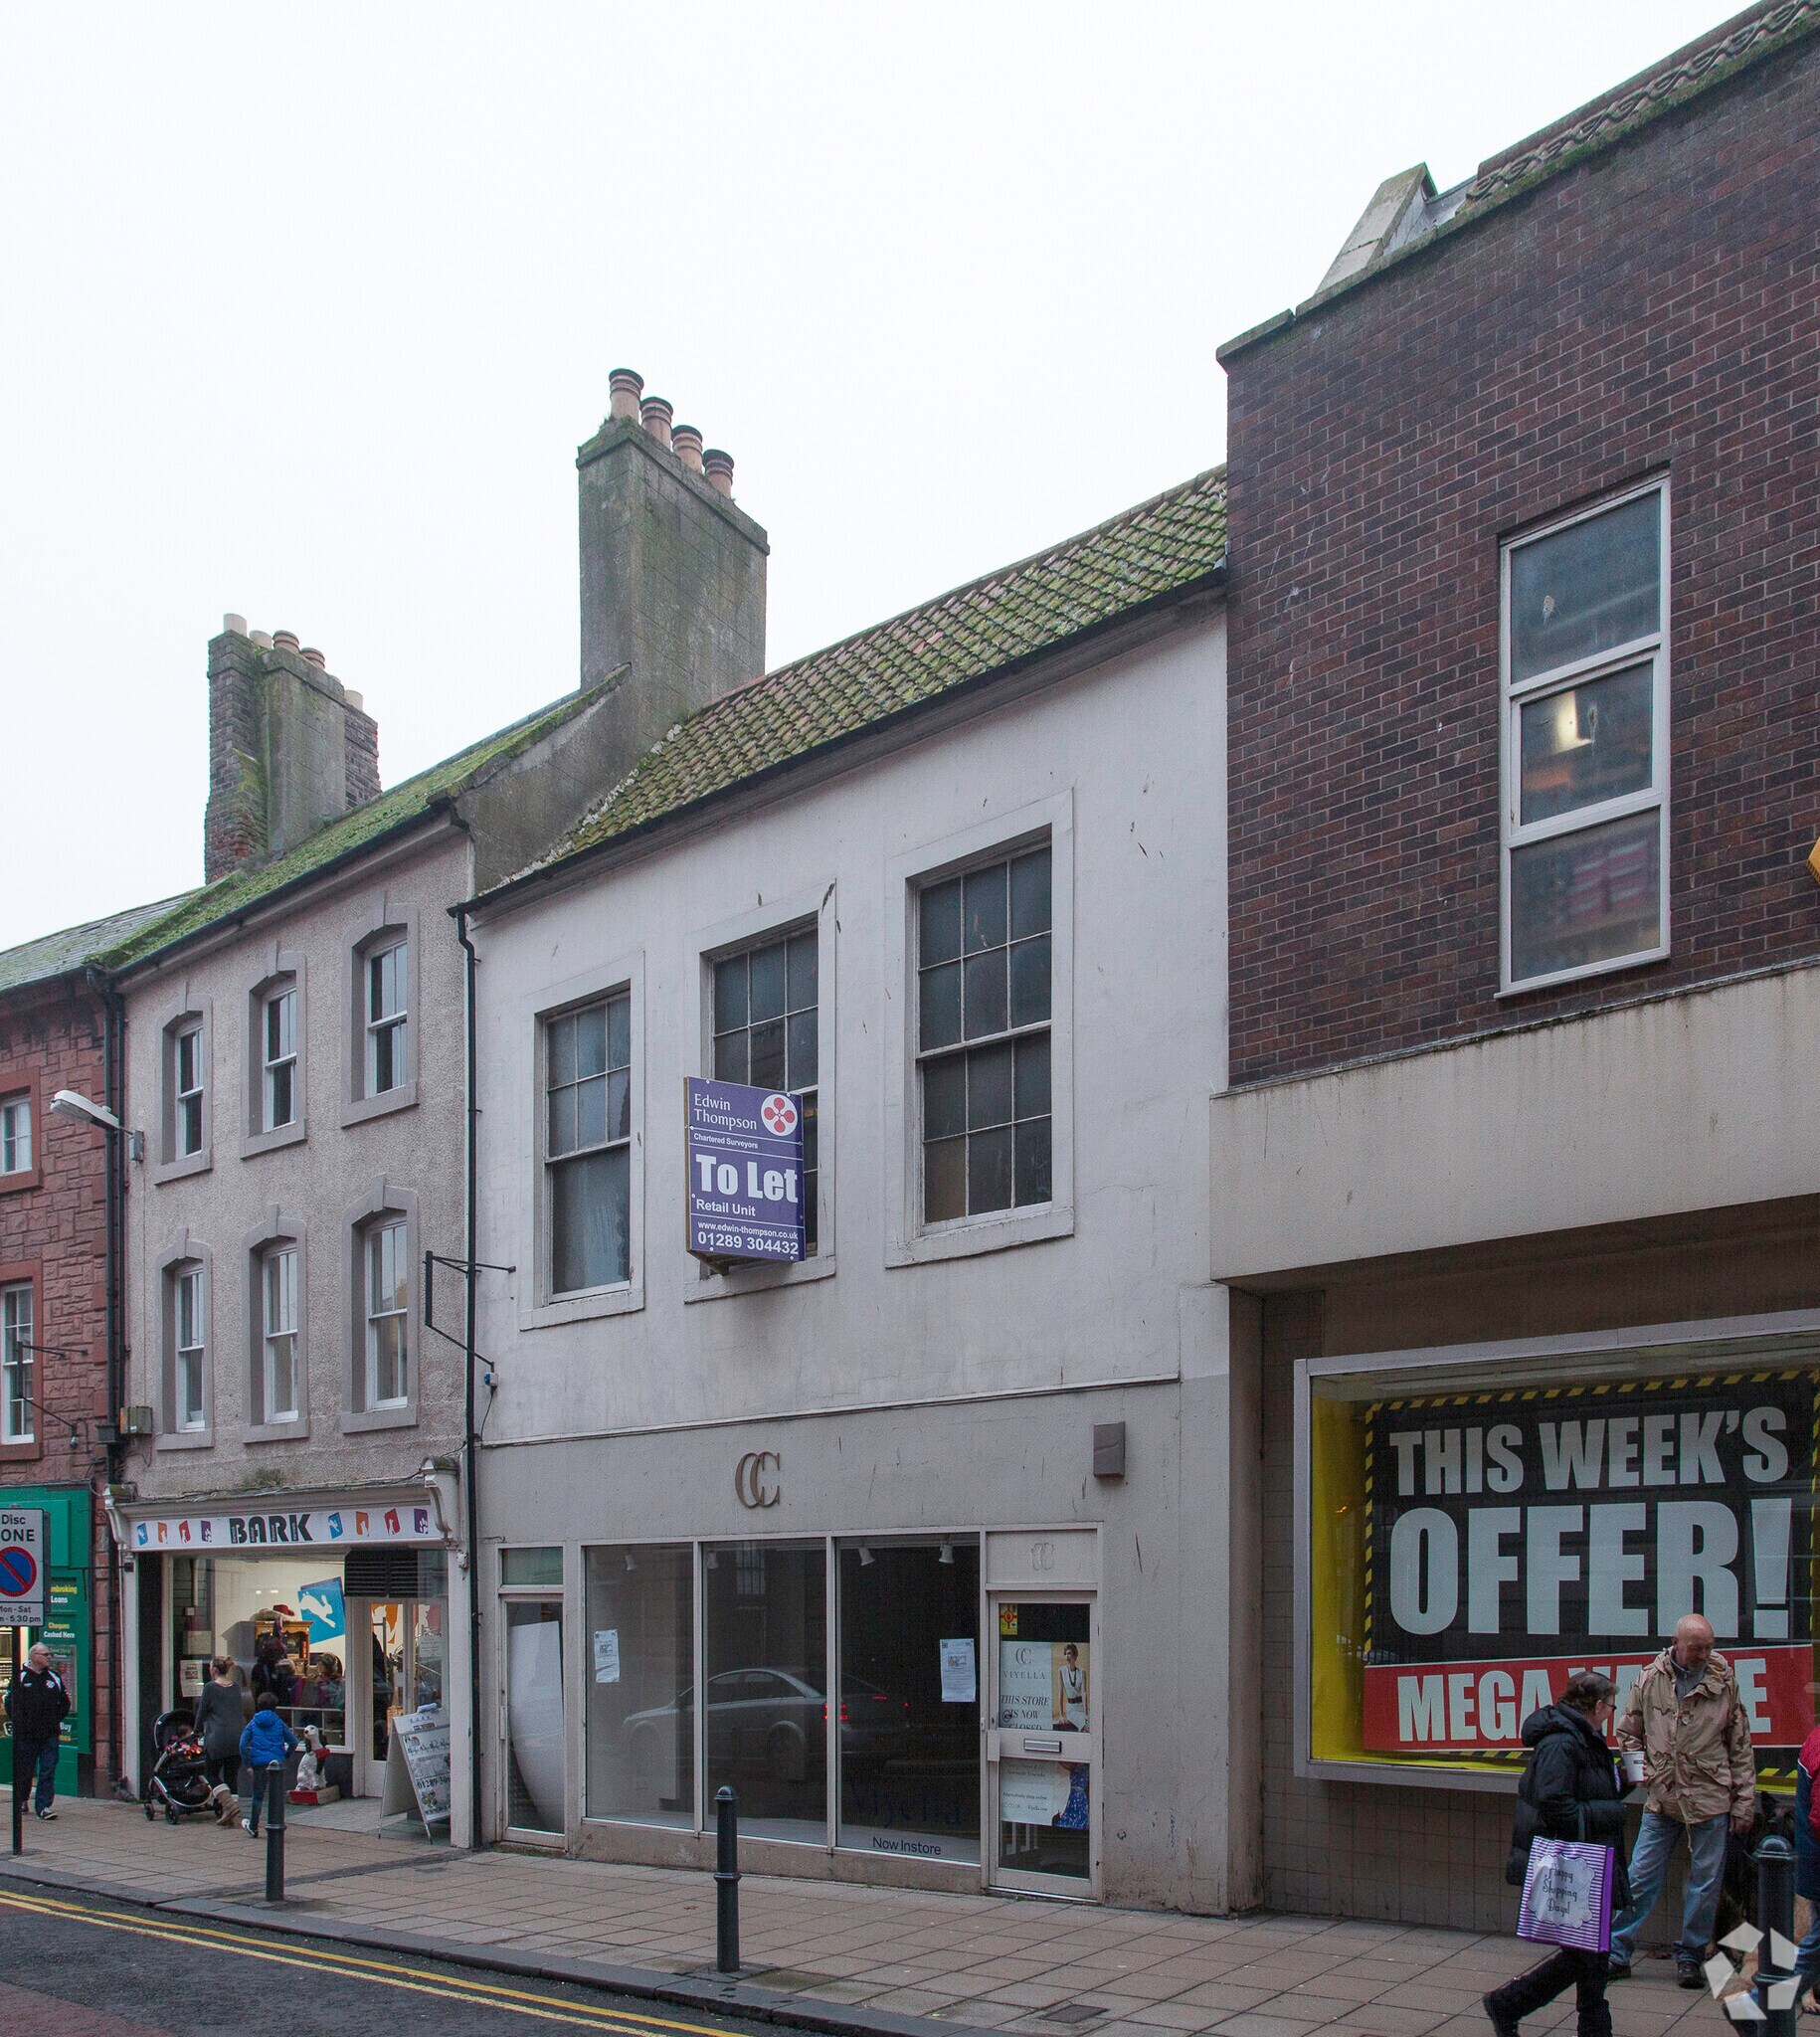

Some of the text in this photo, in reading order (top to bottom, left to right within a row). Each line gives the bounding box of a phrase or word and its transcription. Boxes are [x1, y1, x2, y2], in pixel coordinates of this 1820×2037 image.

[694, 1093, 731, 1111] Edwin
[694, 1108, 757, 1131] Thompson
[693, 1133, 759, 1150] Chartered Surveyors
[695, 1154, 799, 1204] To Let
[696, 1199, 756, 1216] Retail Unit
[697, 1221, 799, 1239] www.edwin-thompson.co.uk
[697, 1231, 800, 1255] 01289 304432
[1388, 1406, 1788, 1497] THIS WEEK'S
[2, 1514, 26, 1525] Disc
[0, 1529, 35, 1542] ONE
[229, 1514, 313, 1544] BARK
[1389, 1497, 1792, 1640] OFFER!
[1002, 1670, 1046, 1680] VIYELLA
[1001, 1694, 1050, 1707] THIS STORE
[1397, 1669, 1553, 1742] MEGA
[1010, 1709, 1041, 1720] IS NOW
[60, 1722, 72, 1732] Buy
[417, 1778, 438, 1789] 01289
[872, 1836, 942, 1856] Now Instore
[1545, 1864, 1573, 1883] Happy
